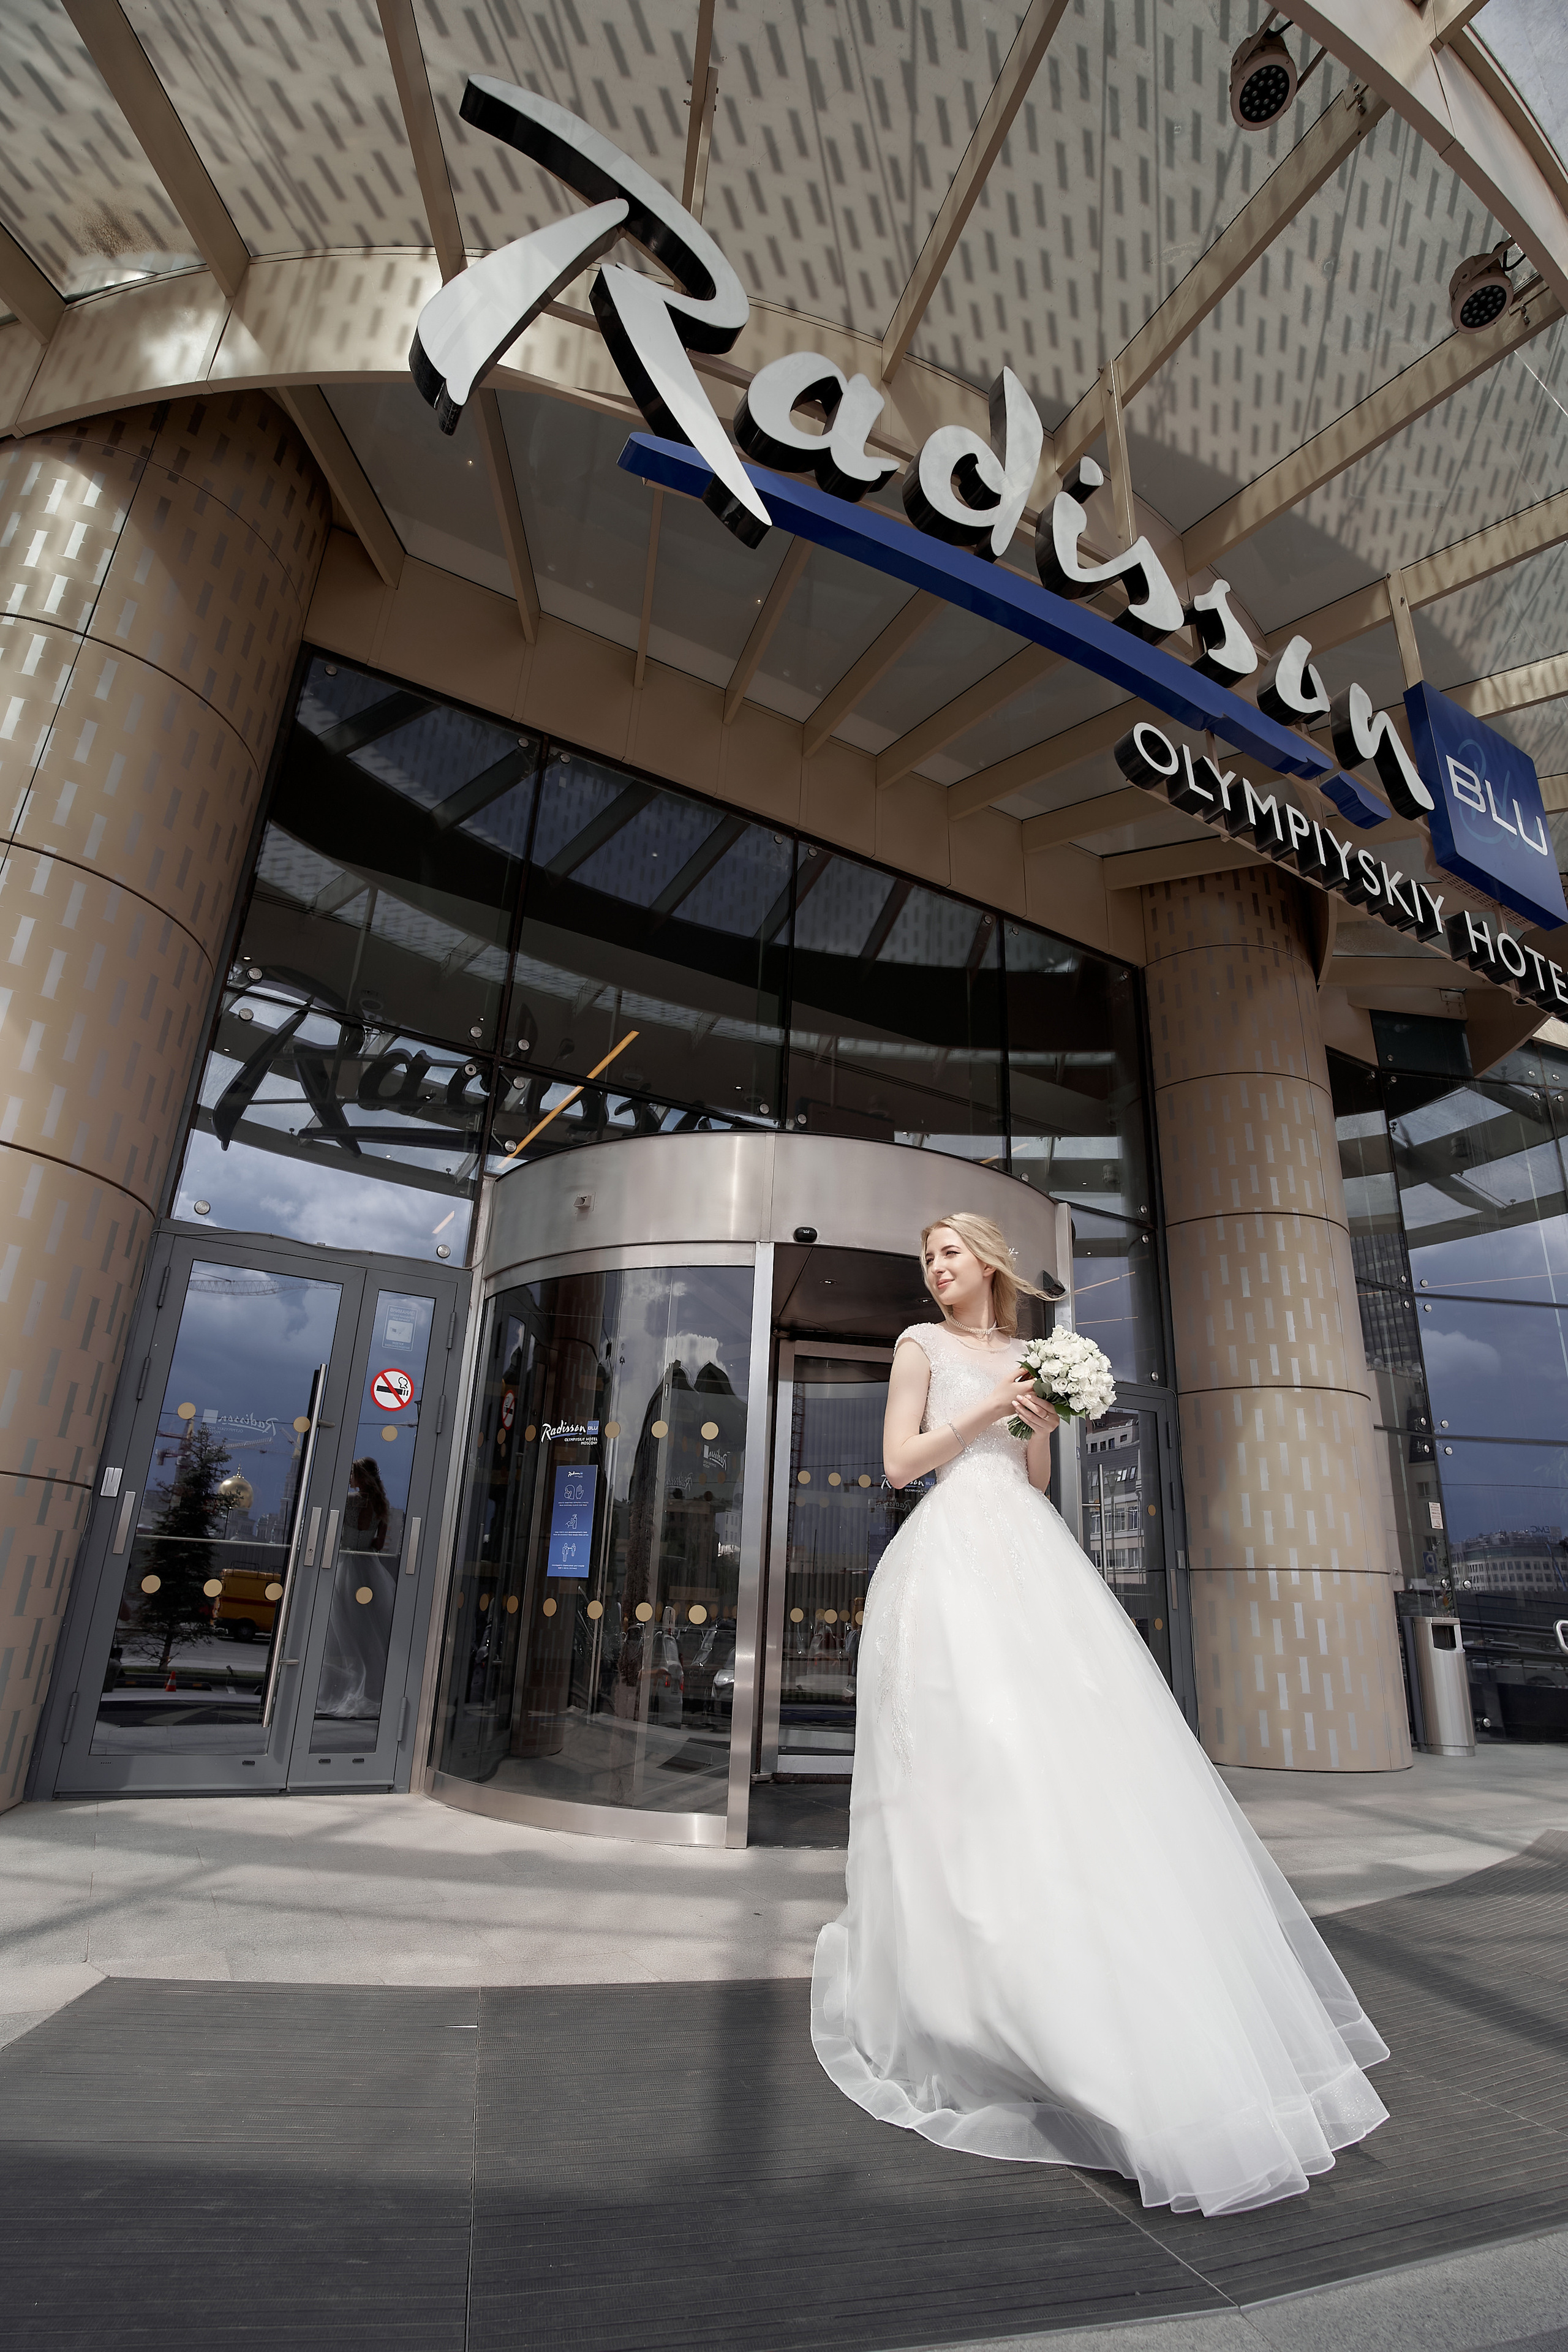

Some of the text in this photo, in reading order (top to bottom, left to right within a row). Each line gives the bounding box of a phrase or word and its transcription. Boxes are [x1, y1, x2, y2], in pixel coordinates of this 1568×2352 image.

[413, 73, 1435, 813] Radisson
[1133, 722, 1568, 1006] OLYMPIYSKIY HOTE
[1446, 754, 1548, 856] BLU
[541, 1419, 586, 1443] Radisson
